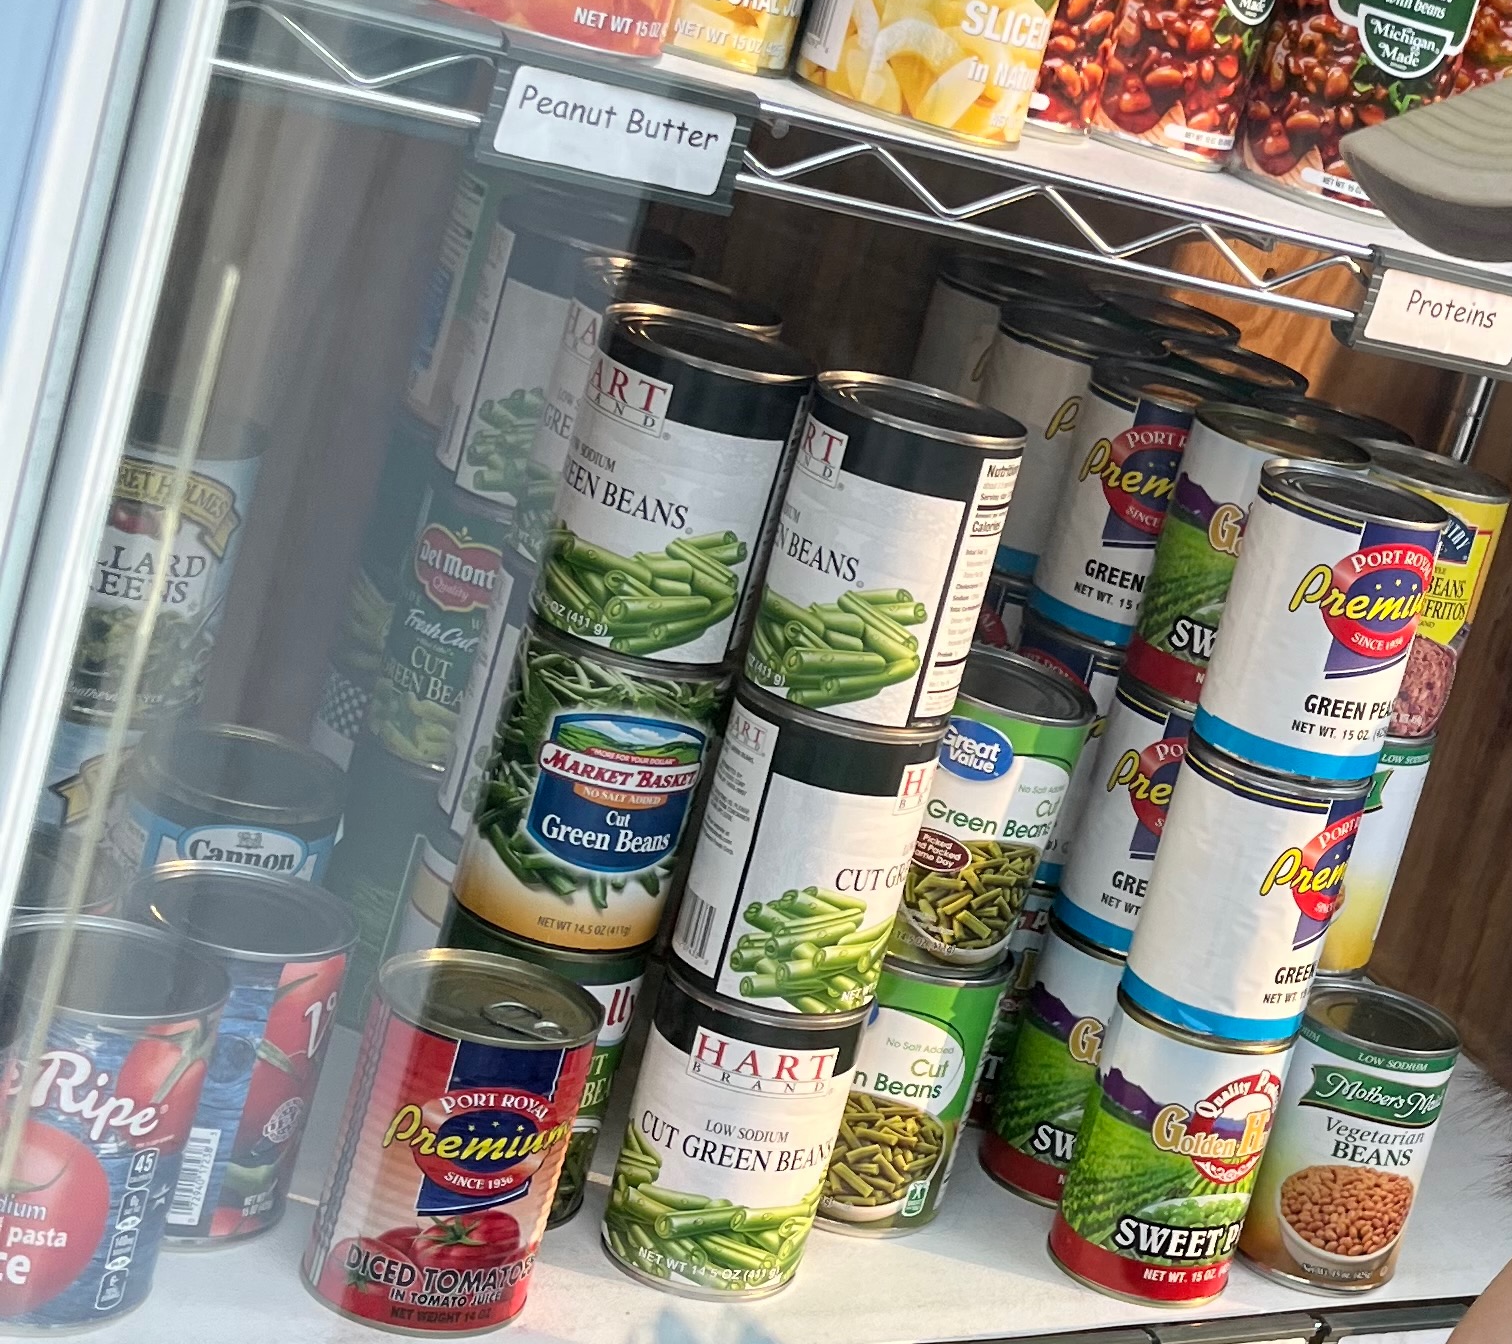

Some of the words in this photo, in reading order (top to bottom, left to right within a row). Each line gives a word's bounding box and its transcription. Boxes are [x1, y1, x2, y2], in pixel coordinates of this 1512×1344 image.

[574, 6, 607, 31] NET
[610, 12, 634, 35] WT
[636, 20, 649, 39] 15
[674, 18, 706, 41] NET
[707, 27, 731, 46] WT
[1370, 16, 1439, 53] Michigan
[1378, 42, 1421, 68] Made
[967, 57, 989, 83] in
[518, 84, 617, 129] Peanut
[625, 108, 719, 151] Butter
[1407, 289, 1497, 329] Proteins
[1126, 429, 1176, 450] PORT
[580, 443, 618, 474] SODIUM
[600, 479, 689, 532] BEANS
[420, 539, 445, 566] Del
[784, 535, 862, 584] BEANS
[1351, 549, 1403, 575] PORT
[1084, 558, 1146, 593] GREEN
[1074, 581, 1094, 600] NET
[1096, 590, 1115, 606] WT.
[1118, 597, 1134, 610] 15
[404, 608, 441, 638] Fresh
[1350, 631, 1385, 651] SINCE
[410, 645, 454, 680] CUT
[1303, 694, 1367, 721] GREEN
[1291, 718, 1315, 736] NET
[1317, 724, 1338, 740] WT.
[1342, 728, 1356, 741] 15
[941, 725, 1001, 762] Great
[543, 749, 634, 786] MARKET
[635, 770, 697, 788] BASKET
[949, 750, 995, 774] Value
[1381, 753, 1403, 763] LOW
[584, 786, 600, 797] NO
[600, 790, 627, 803] SALT
[628, 796, 662, 805] ADDED
[1017, 784, 1031, 793] No
[1032, 785, 1048, 796] Salt
[605, 810, 631, 828] Cut
[926, 799, 998, 836] Green
[541, 814, 611, 851] Green
[614, 830, 671, 853] Beans
[922, 833, 953, 850] Picked
[188, 838, 296, 872] Cannon
[927, 844, 962, 862] Packed
[934, 855, 954, 868] Day
[834, 867, 881, 893] CUT
[1100, 892, 1121, 910] NET
[537, 915, 556, 928] NET
[557, 920, 573, 932] WT
[574, 923, 593, 934] 14.5
[594, 925, 606, 936] OZ
[1262, 992, 1283, 1004] NET
[697, 1033, 836, 1083] HART
[885, 1036, 900, 1047] No
[900, 1039, 919, 1052] Salt
[920, 1044, 955, 1055] Added
[909, 1057, 950, 1079] Cut
[1356, 1051, 1385, 1067] LOW
[1386, 1058, 1429, 1073] SODIUM
[692, 1060, 827, 1094] BRAND
[873, 1073, 943, 1100] Beans
[29, 1050, 159, 1142] Ripe
[1194, 1081, 1252, 1119] Quality
[1315, 1073, 1407, 1112] Mother's
[440, 1093, 499, 1116] PORT
[500, 1093, 549, 1121] ROYAL
[382, 1103, 575, 1161] Premium
[641, 1108, 679, 1152] CUT
[681, 1134, 773, 1174] GREEN
[776, 1139, 837, 1173] BEANS
[704, 1118, 738, 1138] LOW
[737, 1125, 789, 1144] SODIUM
[1152, 1102, 1236, 1158] Golden
[1324, 1115, 1426, 1146] Vegetarian
[135, 1153, 154, 1173] 45
[1329, 1139, 1415, 1168] BEANS
[443, 1171, 485, 1190] SINCE
[6, 1226, 68, 1248] pasta
[1115, 1216, 1225, 1259] SWEET
[344, 1243, 416, 1286] DICED
[423, 1254, 538, 1294] TOMATOES
[638, 1246, 663, 1265] NET
[666, 1258, 688, 1272] WT
[721, 1269, 741, 1280] OZ
[1143, 1267, 1165, 1282] NET
[1167, 1269, 1188, 1283] WT.
[1191, 1268, 1203, 1283] 15
[389, 1287, 406, 1300] IN
[410, 1291, 468, 1309] TOMATO
[470, 1290, 502, 1306] JUICE
[390, 1308, 414, 1321] NET
[417, 1309, 462, 1323] WEIGHT
